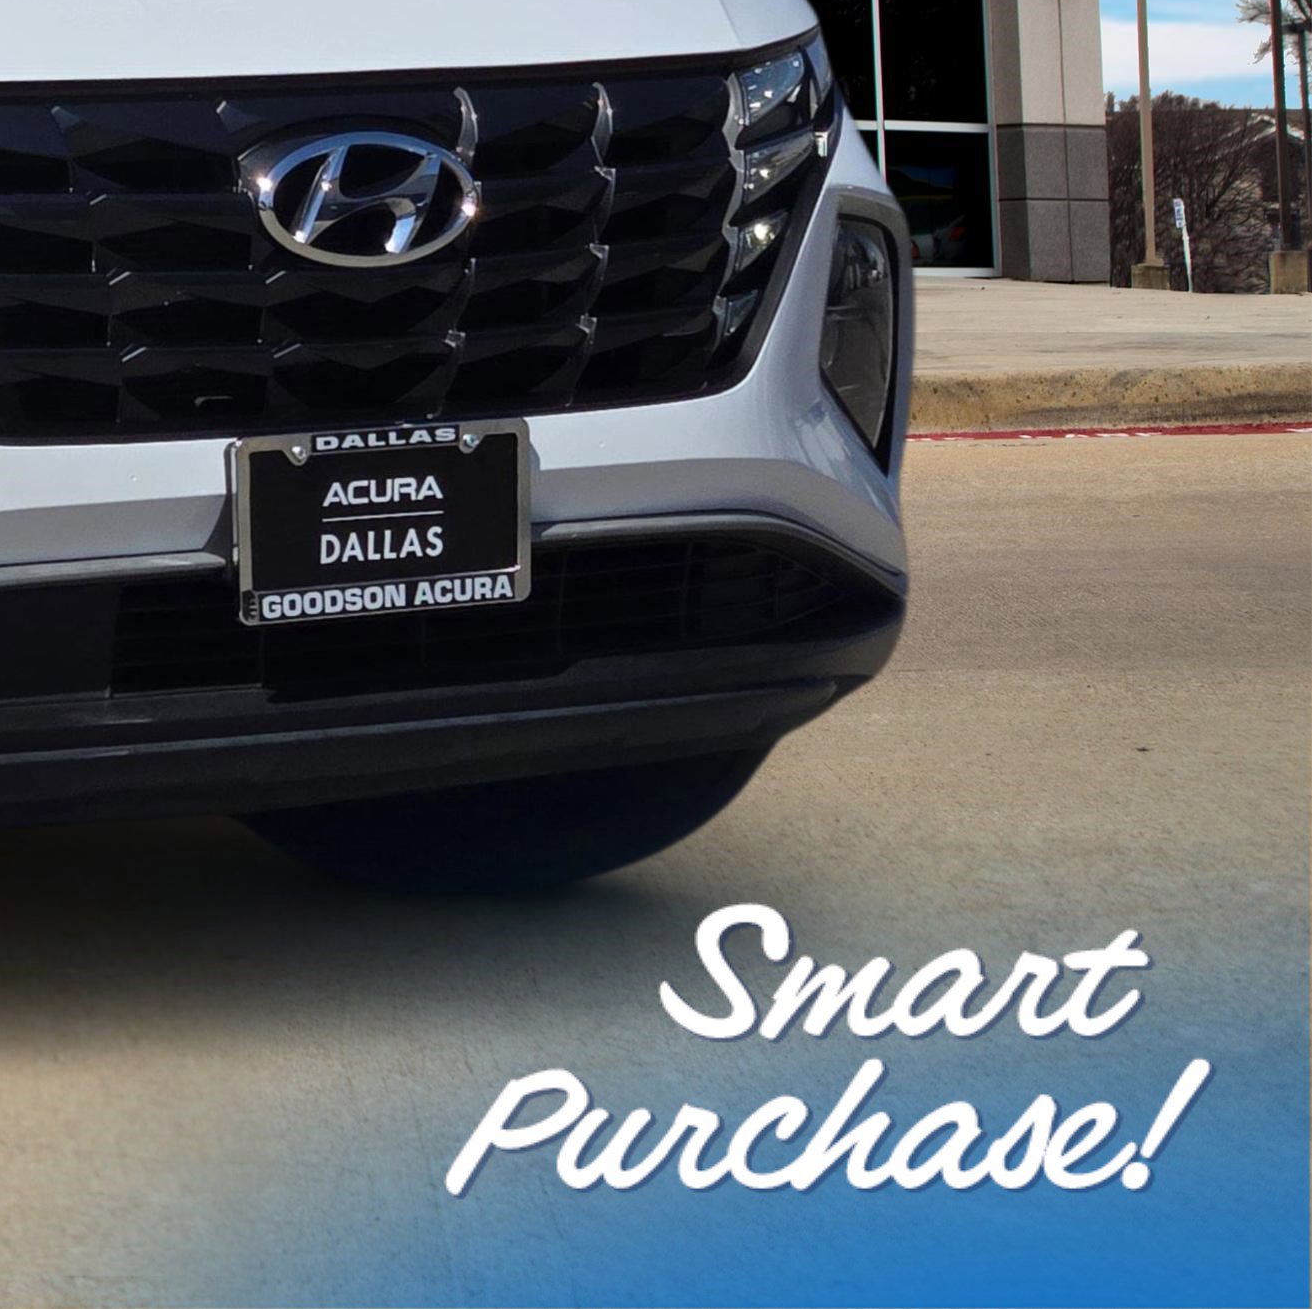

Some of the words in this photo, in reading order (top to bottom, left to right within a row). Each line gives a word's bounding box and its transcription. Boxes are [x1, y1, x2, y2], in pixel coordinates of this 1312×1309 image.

[315, 427, 457, 451] DALLAS
[321, 475, 444, 508] ACURA
[319, 525, 445, 565] DALLAS
[261, 583, 407, 620] GOODSON
[413, 574, 514, 606] ACURA
